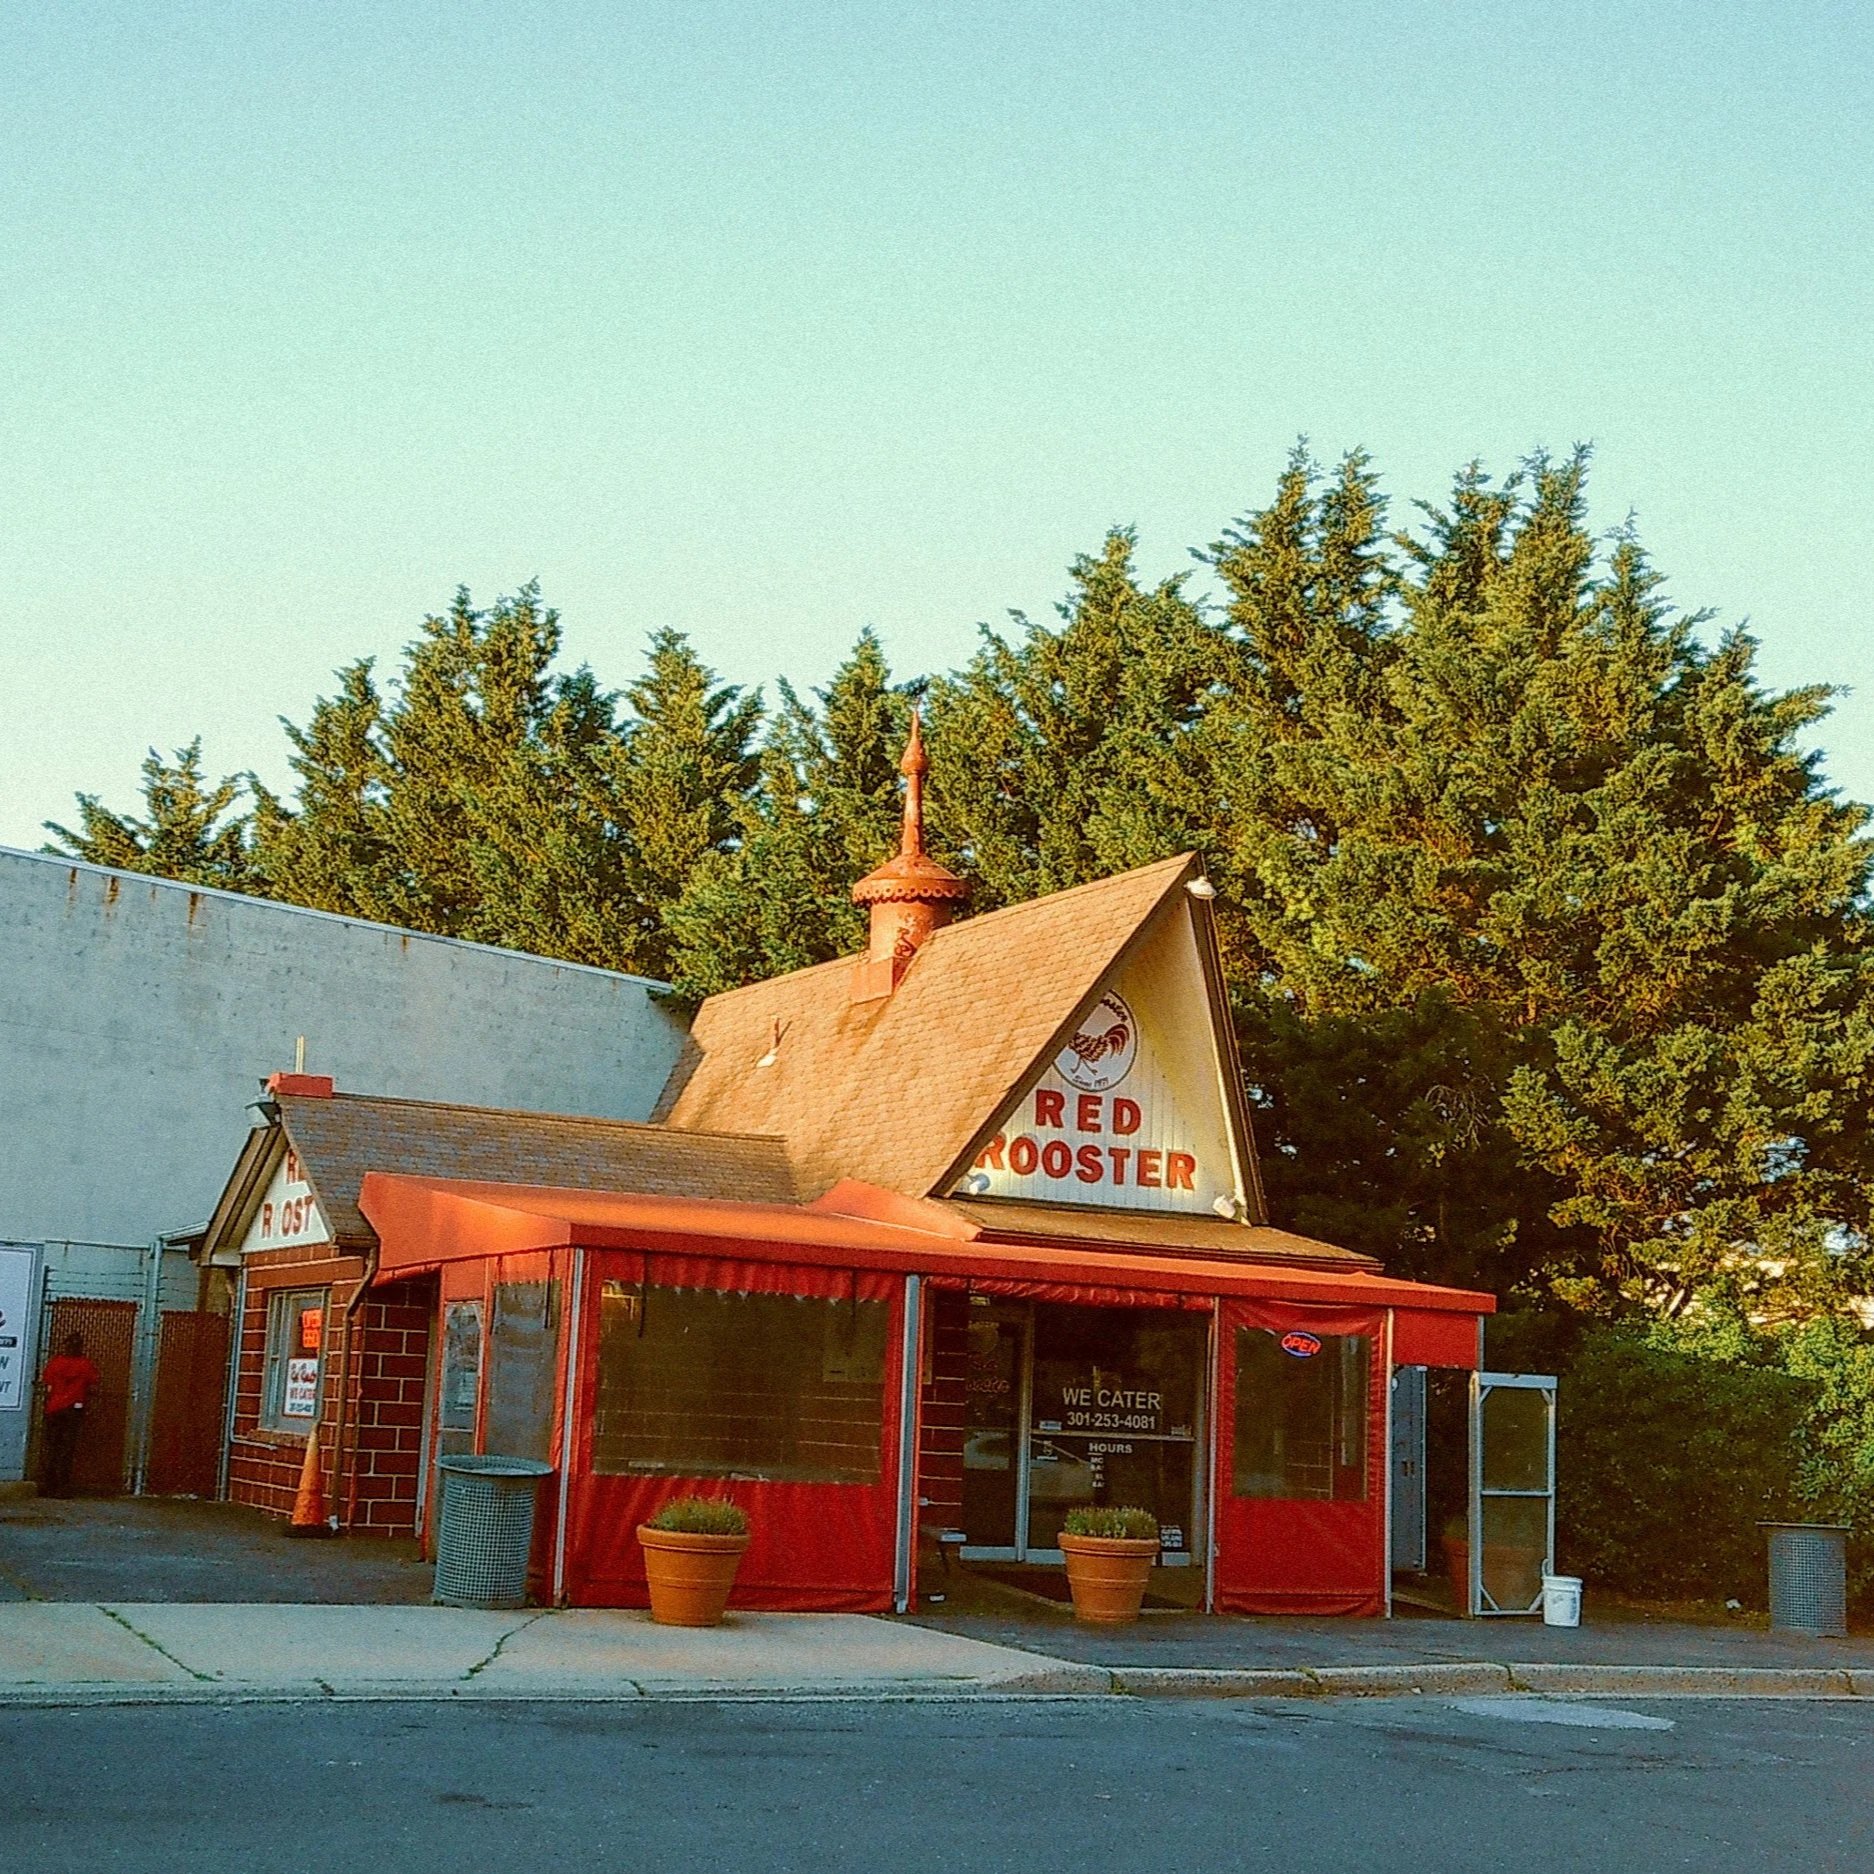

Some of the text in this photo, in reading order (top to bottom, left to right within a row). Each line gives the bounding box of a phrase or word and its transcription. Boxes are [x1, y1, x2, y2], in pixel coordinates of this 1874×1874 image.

[1036, 1089, 1142, 1136] RED
[975, 1132, 1197, 1191] ROOSTER
[1281, 1334, 1322, 1355] OPEN
[1062, 1387, 1162, 1410] WE CATER
[1066, 1411, 1156, 1429] 301-253-4081
[1088, 1443, 1134, 1454] HOURS
